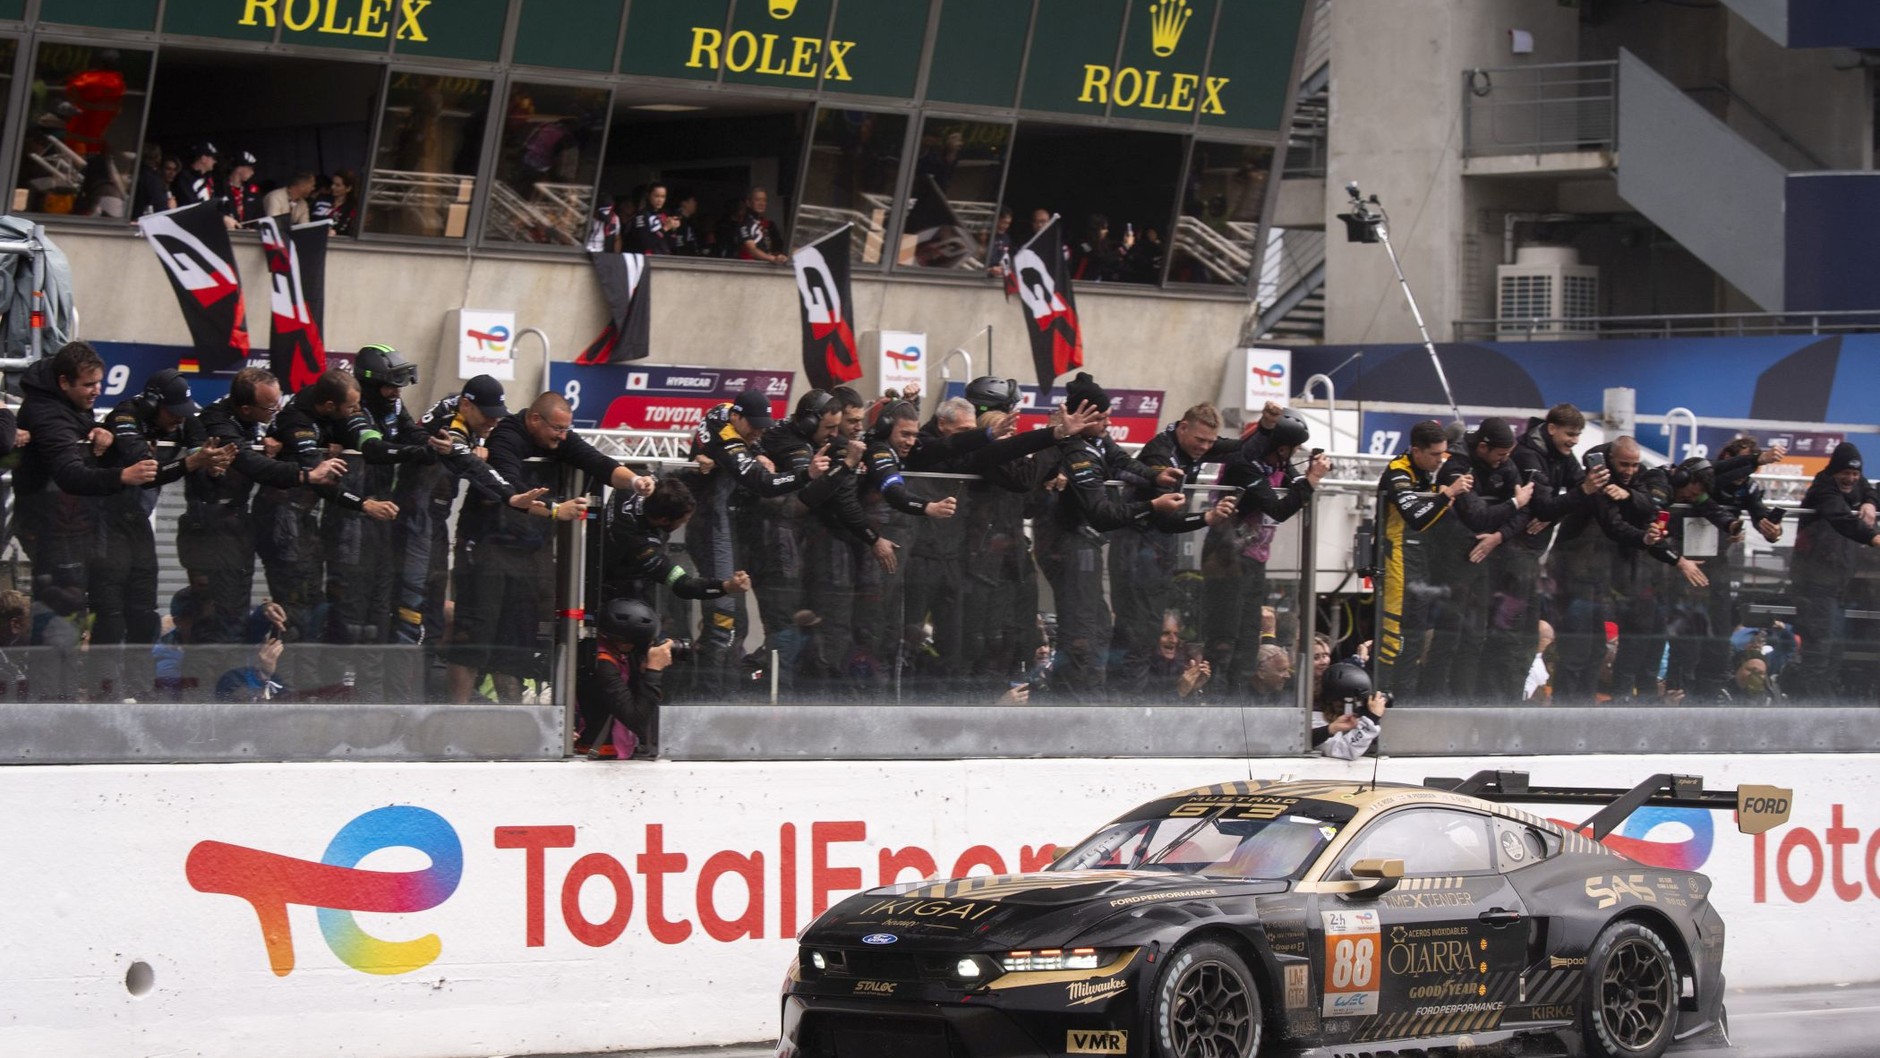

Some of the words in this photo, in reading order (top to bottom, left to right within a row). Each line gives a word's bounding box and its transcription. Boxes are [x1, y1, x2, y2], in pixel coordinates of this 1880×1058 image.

[238, 0, 431, 42] ROLEX
[685, 27, 856, 81] ROLEX
[1078, 64, 1230, 114] ROLEX
[105, 364, 130, 395] 9
[666, 377, 711, 387] HYPERCAR
[565, 380, 581, 411] 8
[645, 406, 702, 422] TOYOTA
[1369, 430, 1401, 456] 87
[1169, 802, 1290, 819] GT3
[1188, 796, 1300, 805] MUSTANG
[1743, 797, 1788, 815] FORD
[1585, 874, 1657, 909] SAS
[860, 899, 997, 920] IKIGAI
[1409, 929, 1431, 937] ACEROS
[1432, 927, 1468, 936] INOXIDABLES
[1333, 938, 1374, 988] 88
[855, 981, 897, 992] STALOC
[1066, 978, 1127, 1000] Milwaukee
[1532, 1007, 1574, 1019] KIRKA
[1073, 1034, 1120, 1050] VMR
